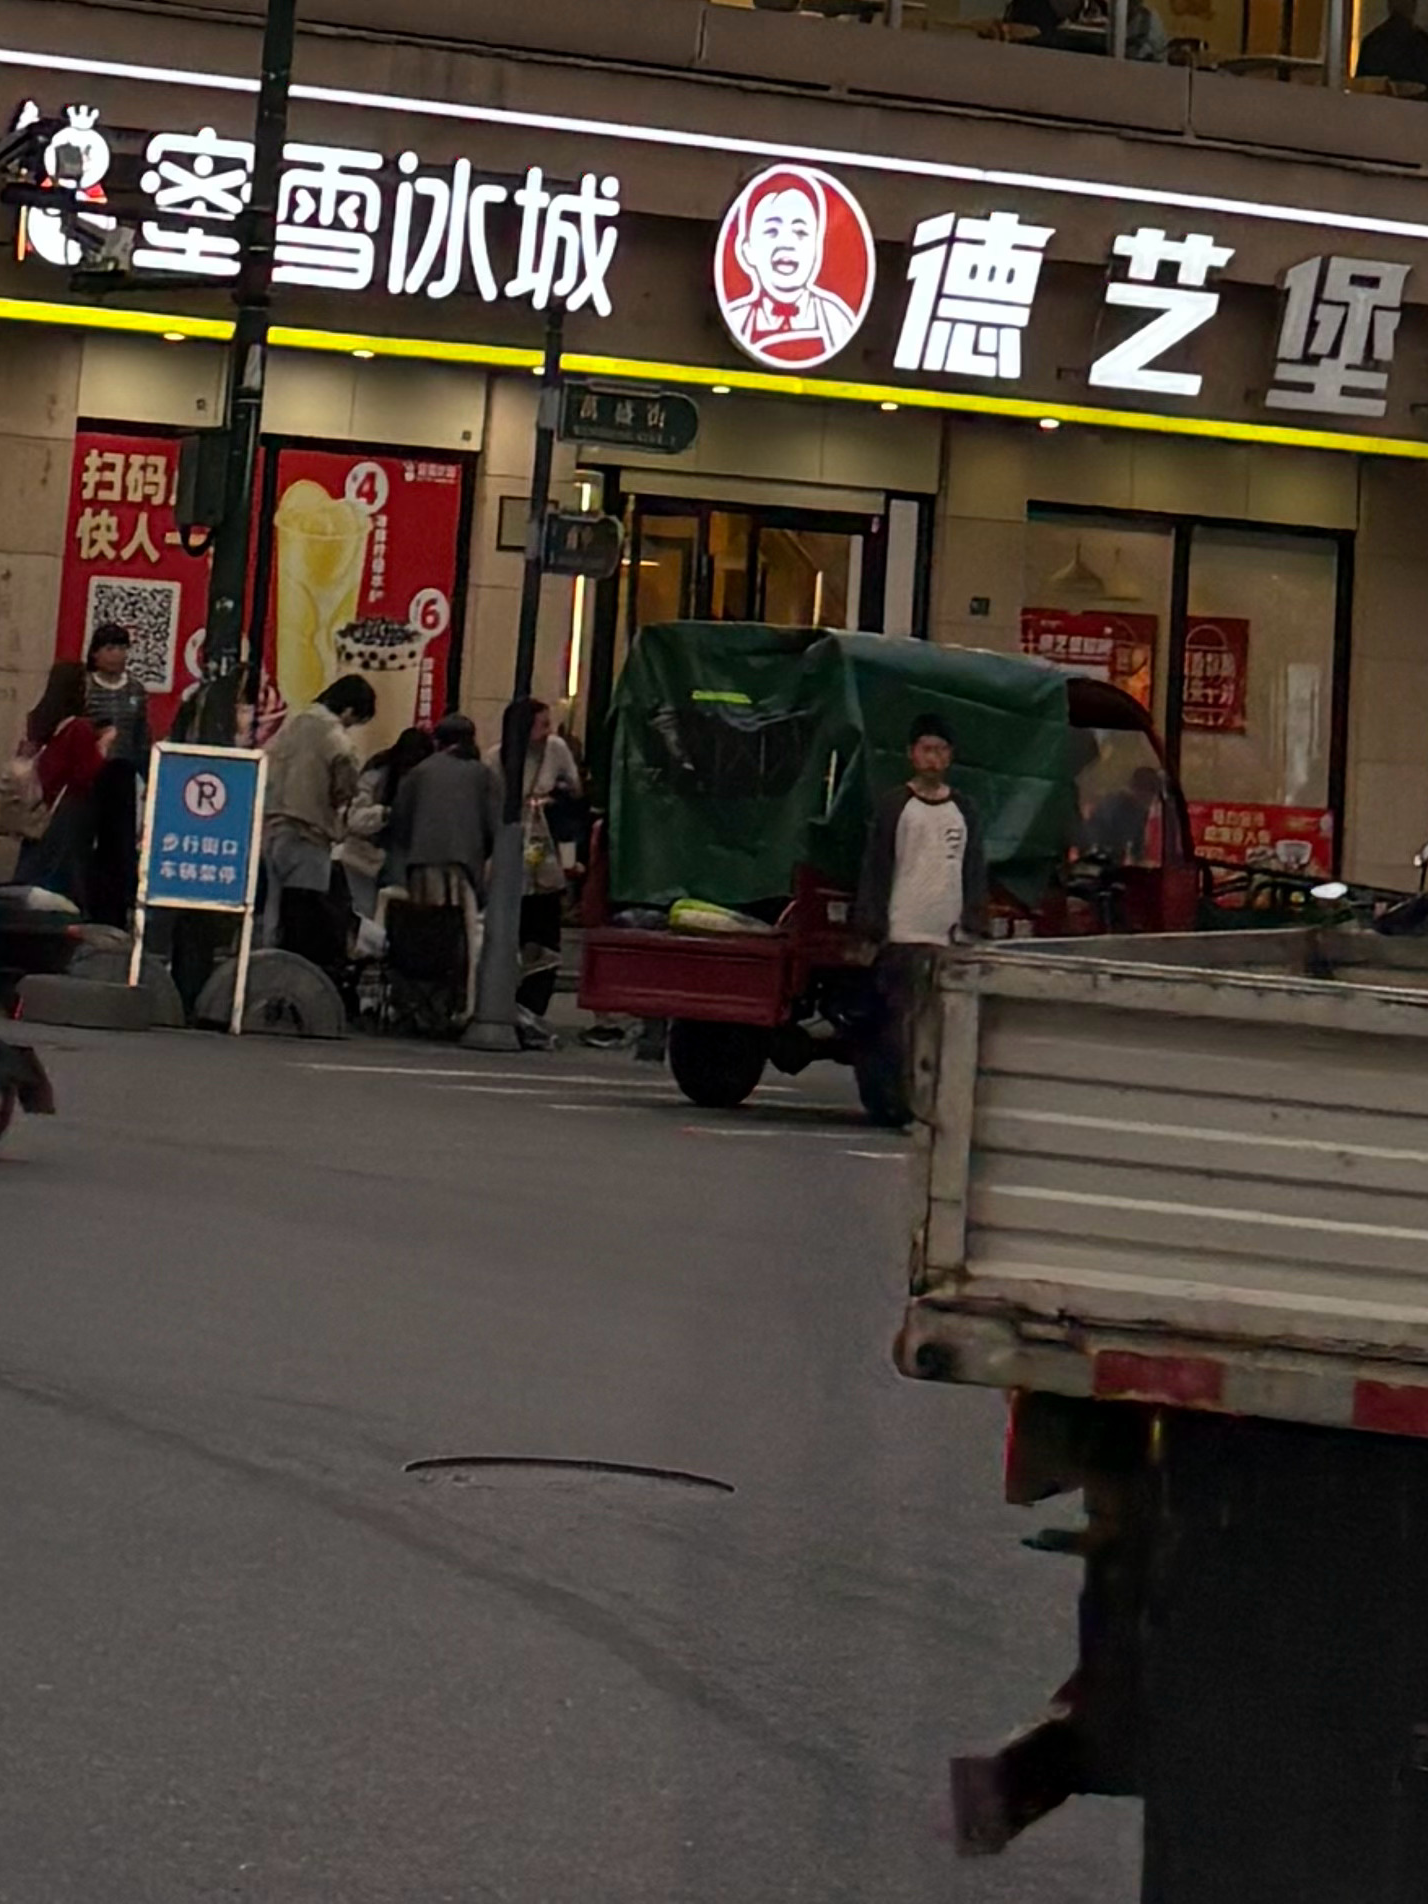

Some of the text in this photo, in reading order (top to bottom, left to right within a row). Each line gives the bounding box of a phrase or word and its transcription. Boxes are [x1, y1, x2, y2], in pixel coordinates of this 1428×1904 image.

[132, 127, 620, 318] 蜜雪冰城
[893, 211, 1413, 417] 德艺堡
[79, 448, 179, 507] 扫码
